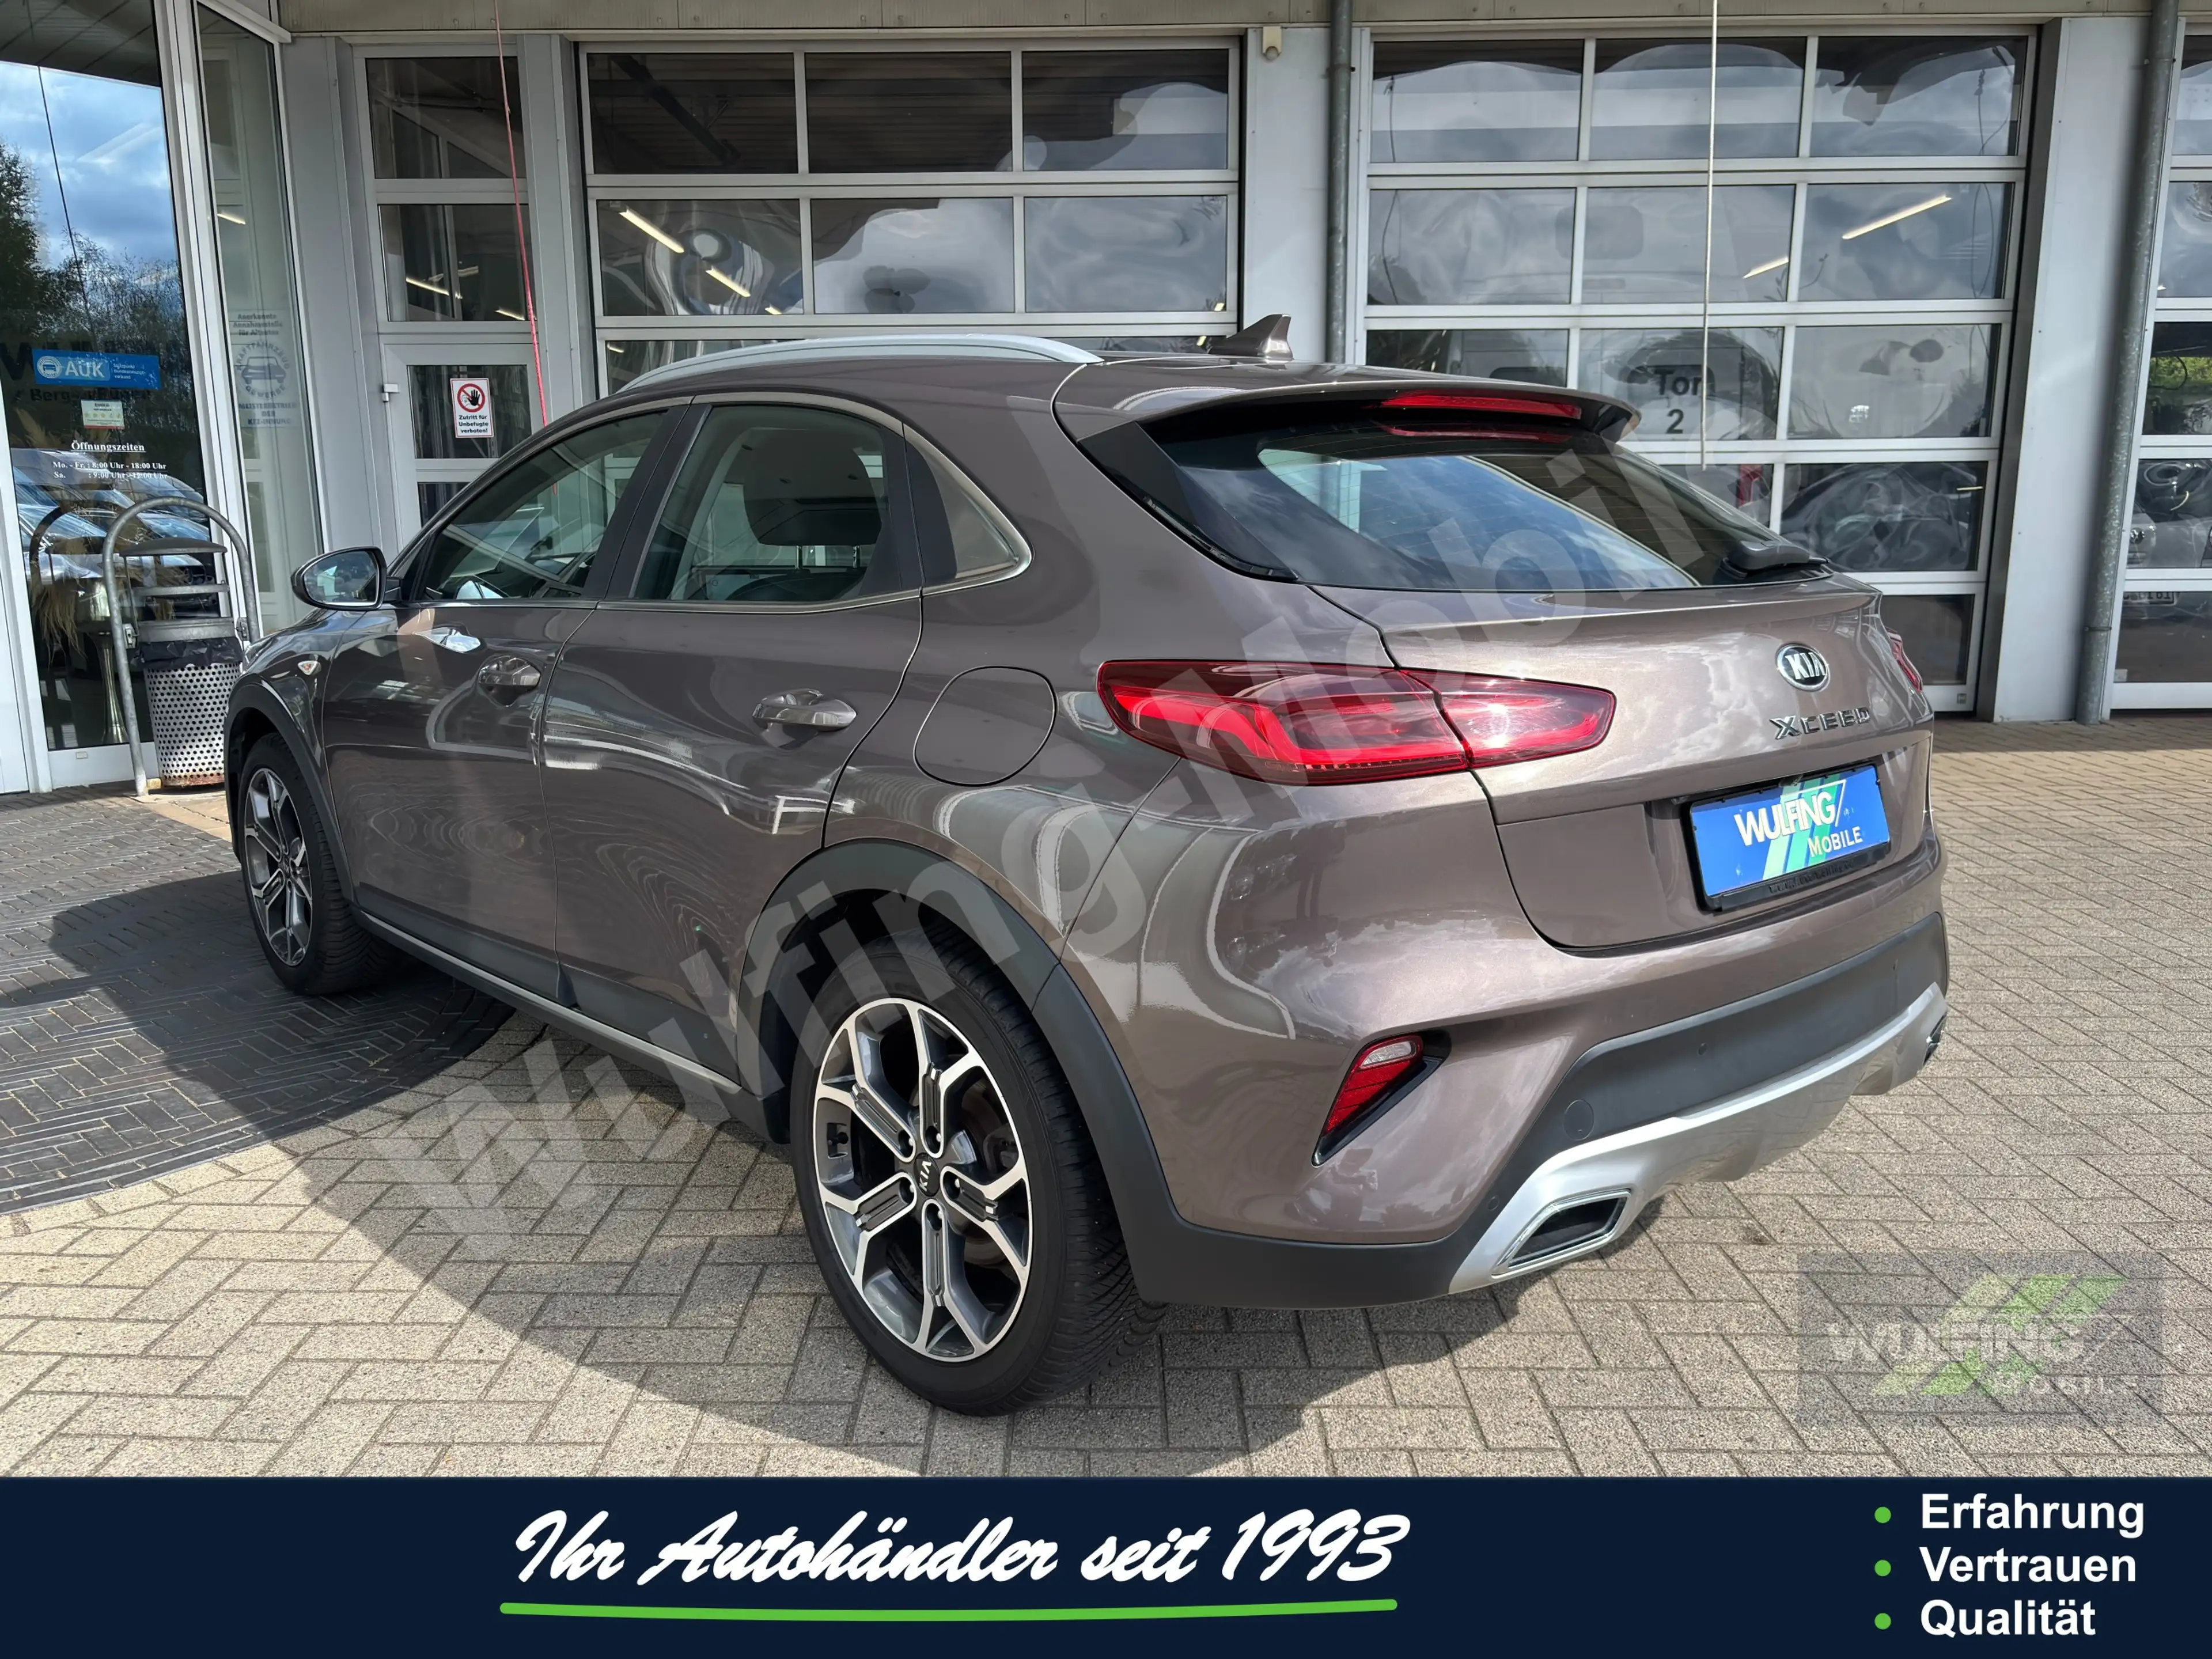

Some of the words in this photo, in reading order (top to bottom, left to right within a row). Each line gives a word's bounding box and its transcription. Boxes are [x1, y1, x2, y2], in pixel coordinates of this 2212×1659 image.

[1654, 370, 1703, 396] Tor
[1666, 409, 1684, 434] 2
[71, 440, 145, 453] Öffnungszeiten
[1785, 652, 1826, 680] KIA
[1770, 707, 1871, 740] XCEED
[1734, 791, 1836, 846] WULFING
[919, 1160, 932, 1192] KIA
